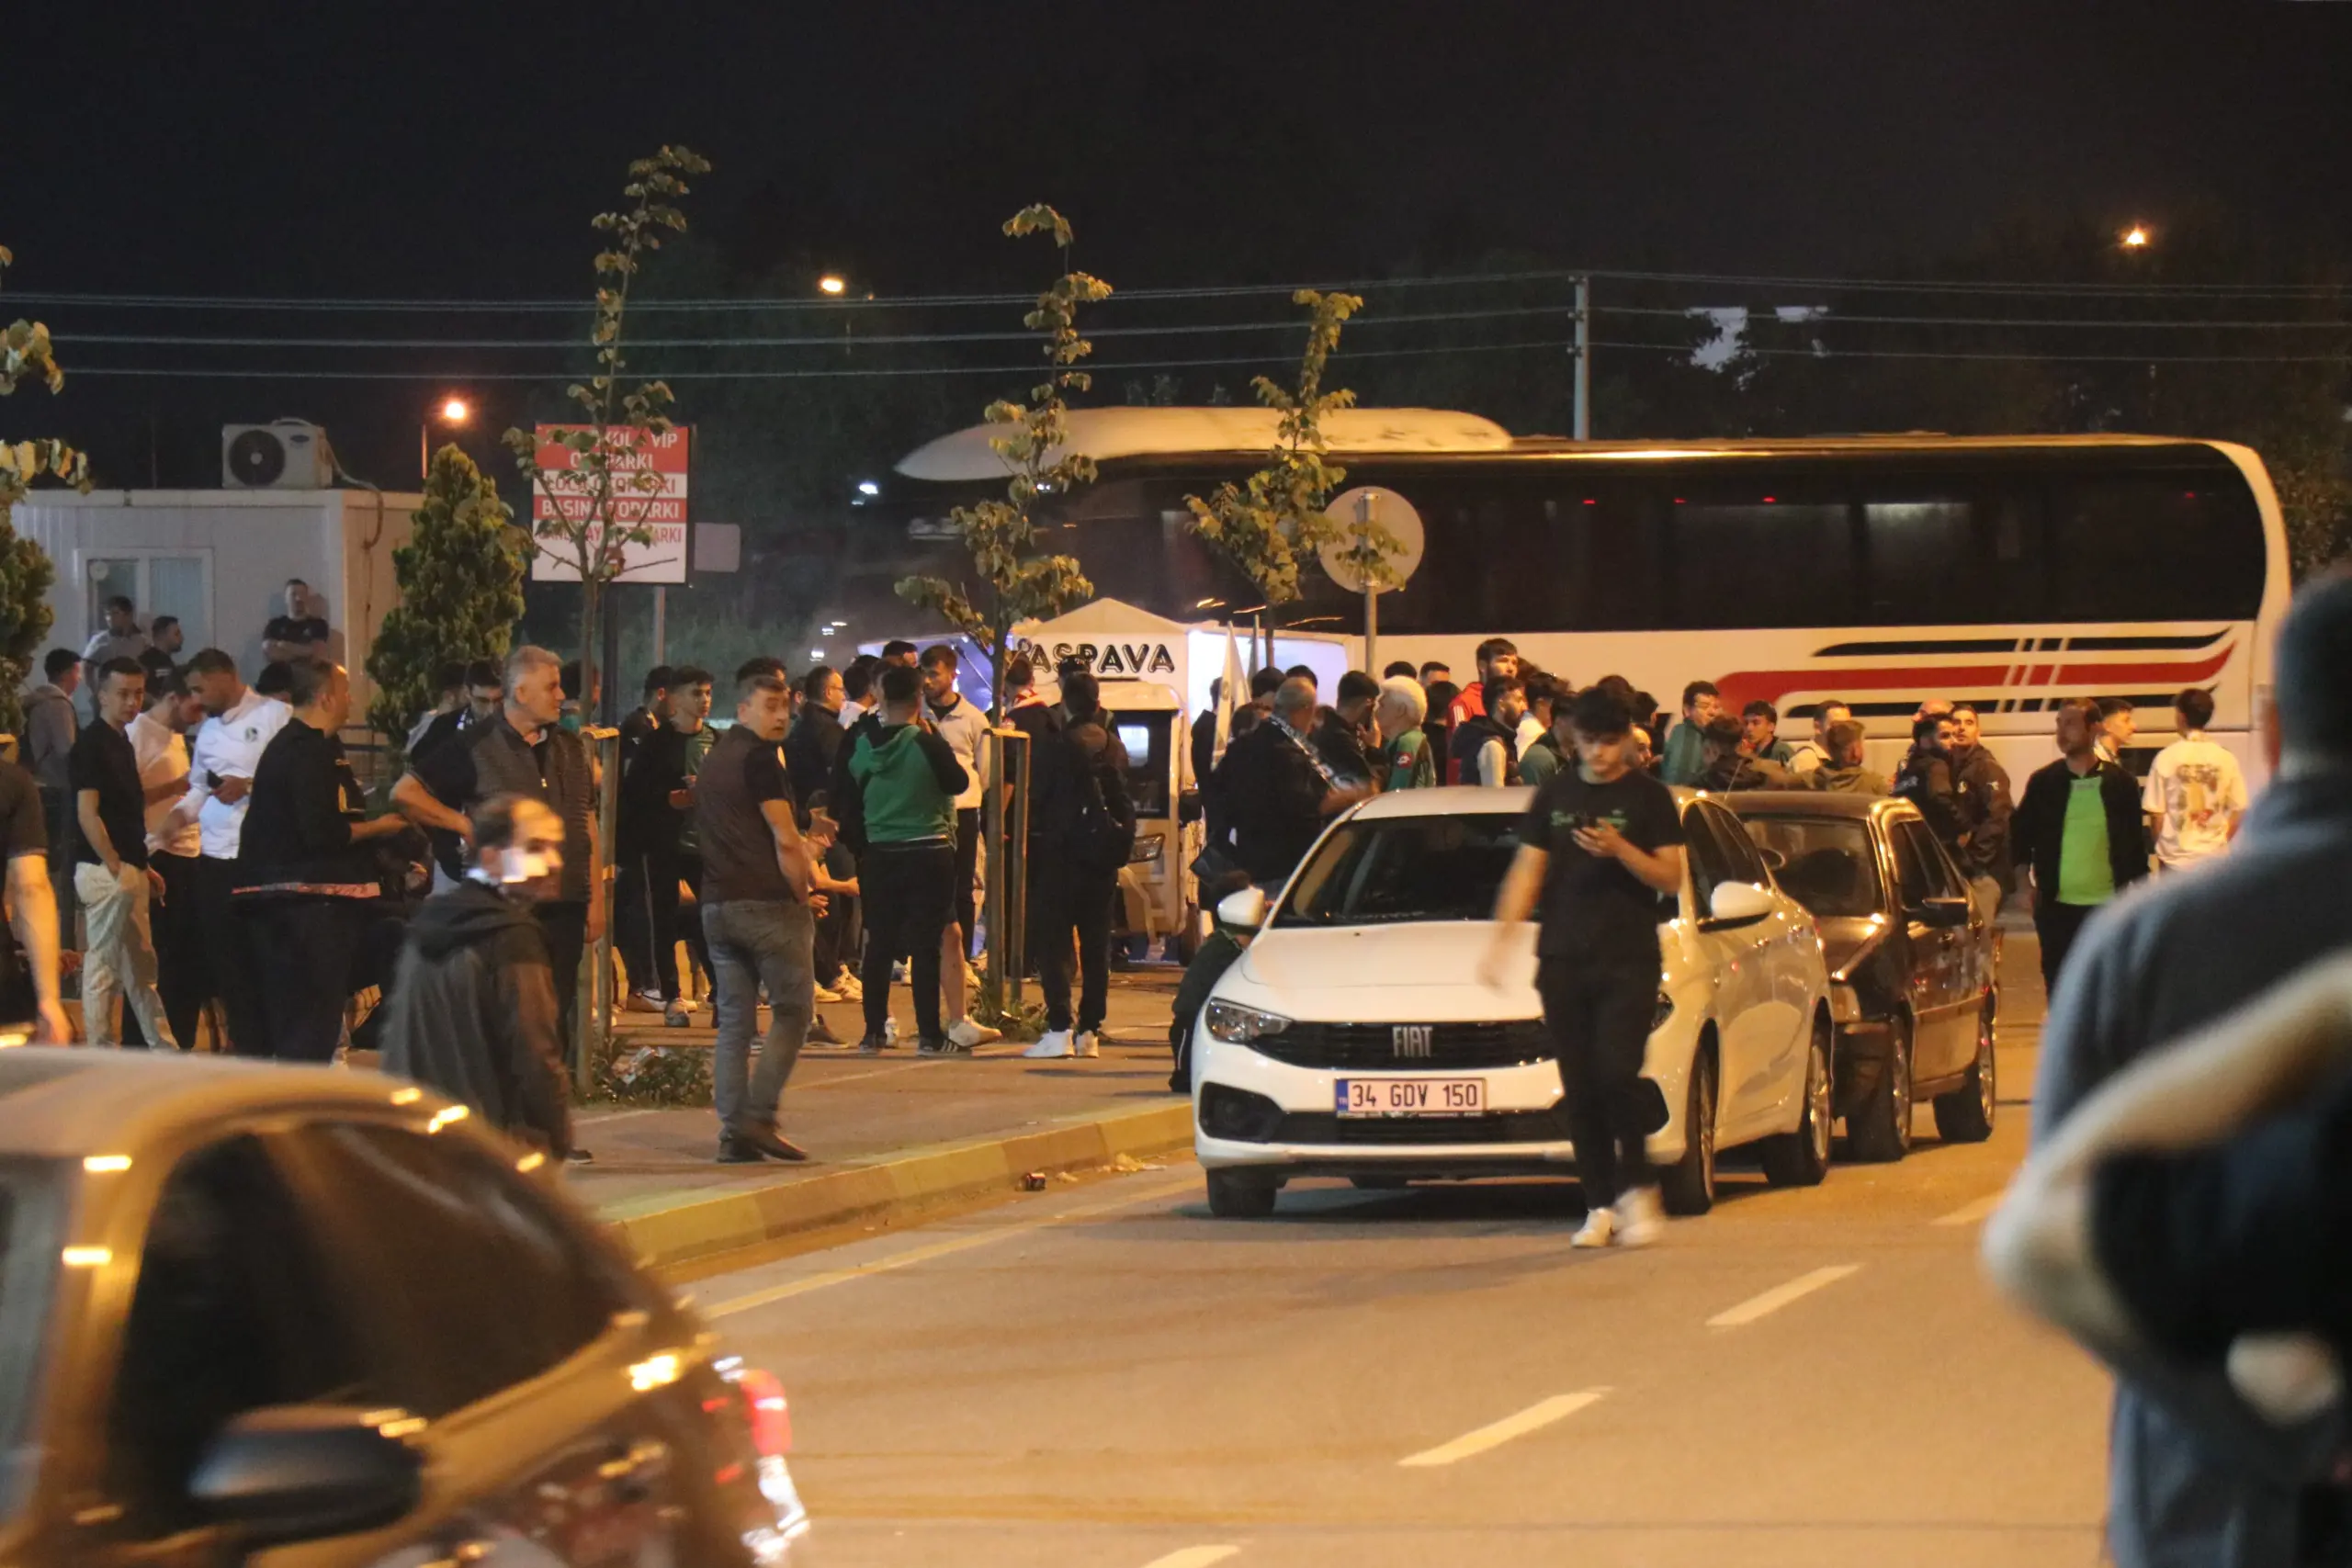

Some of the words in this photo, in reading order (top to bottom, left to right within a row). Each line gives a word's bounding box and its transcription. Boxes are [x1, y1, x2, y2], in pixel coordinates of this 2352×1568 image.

[651, 433, 677, 448] VIP
[1392, 1026, 1433, 1058] FIAT
[1352, 1084, 1377, 1107] 34
[1443, 1084, 1477, 1107] 150
